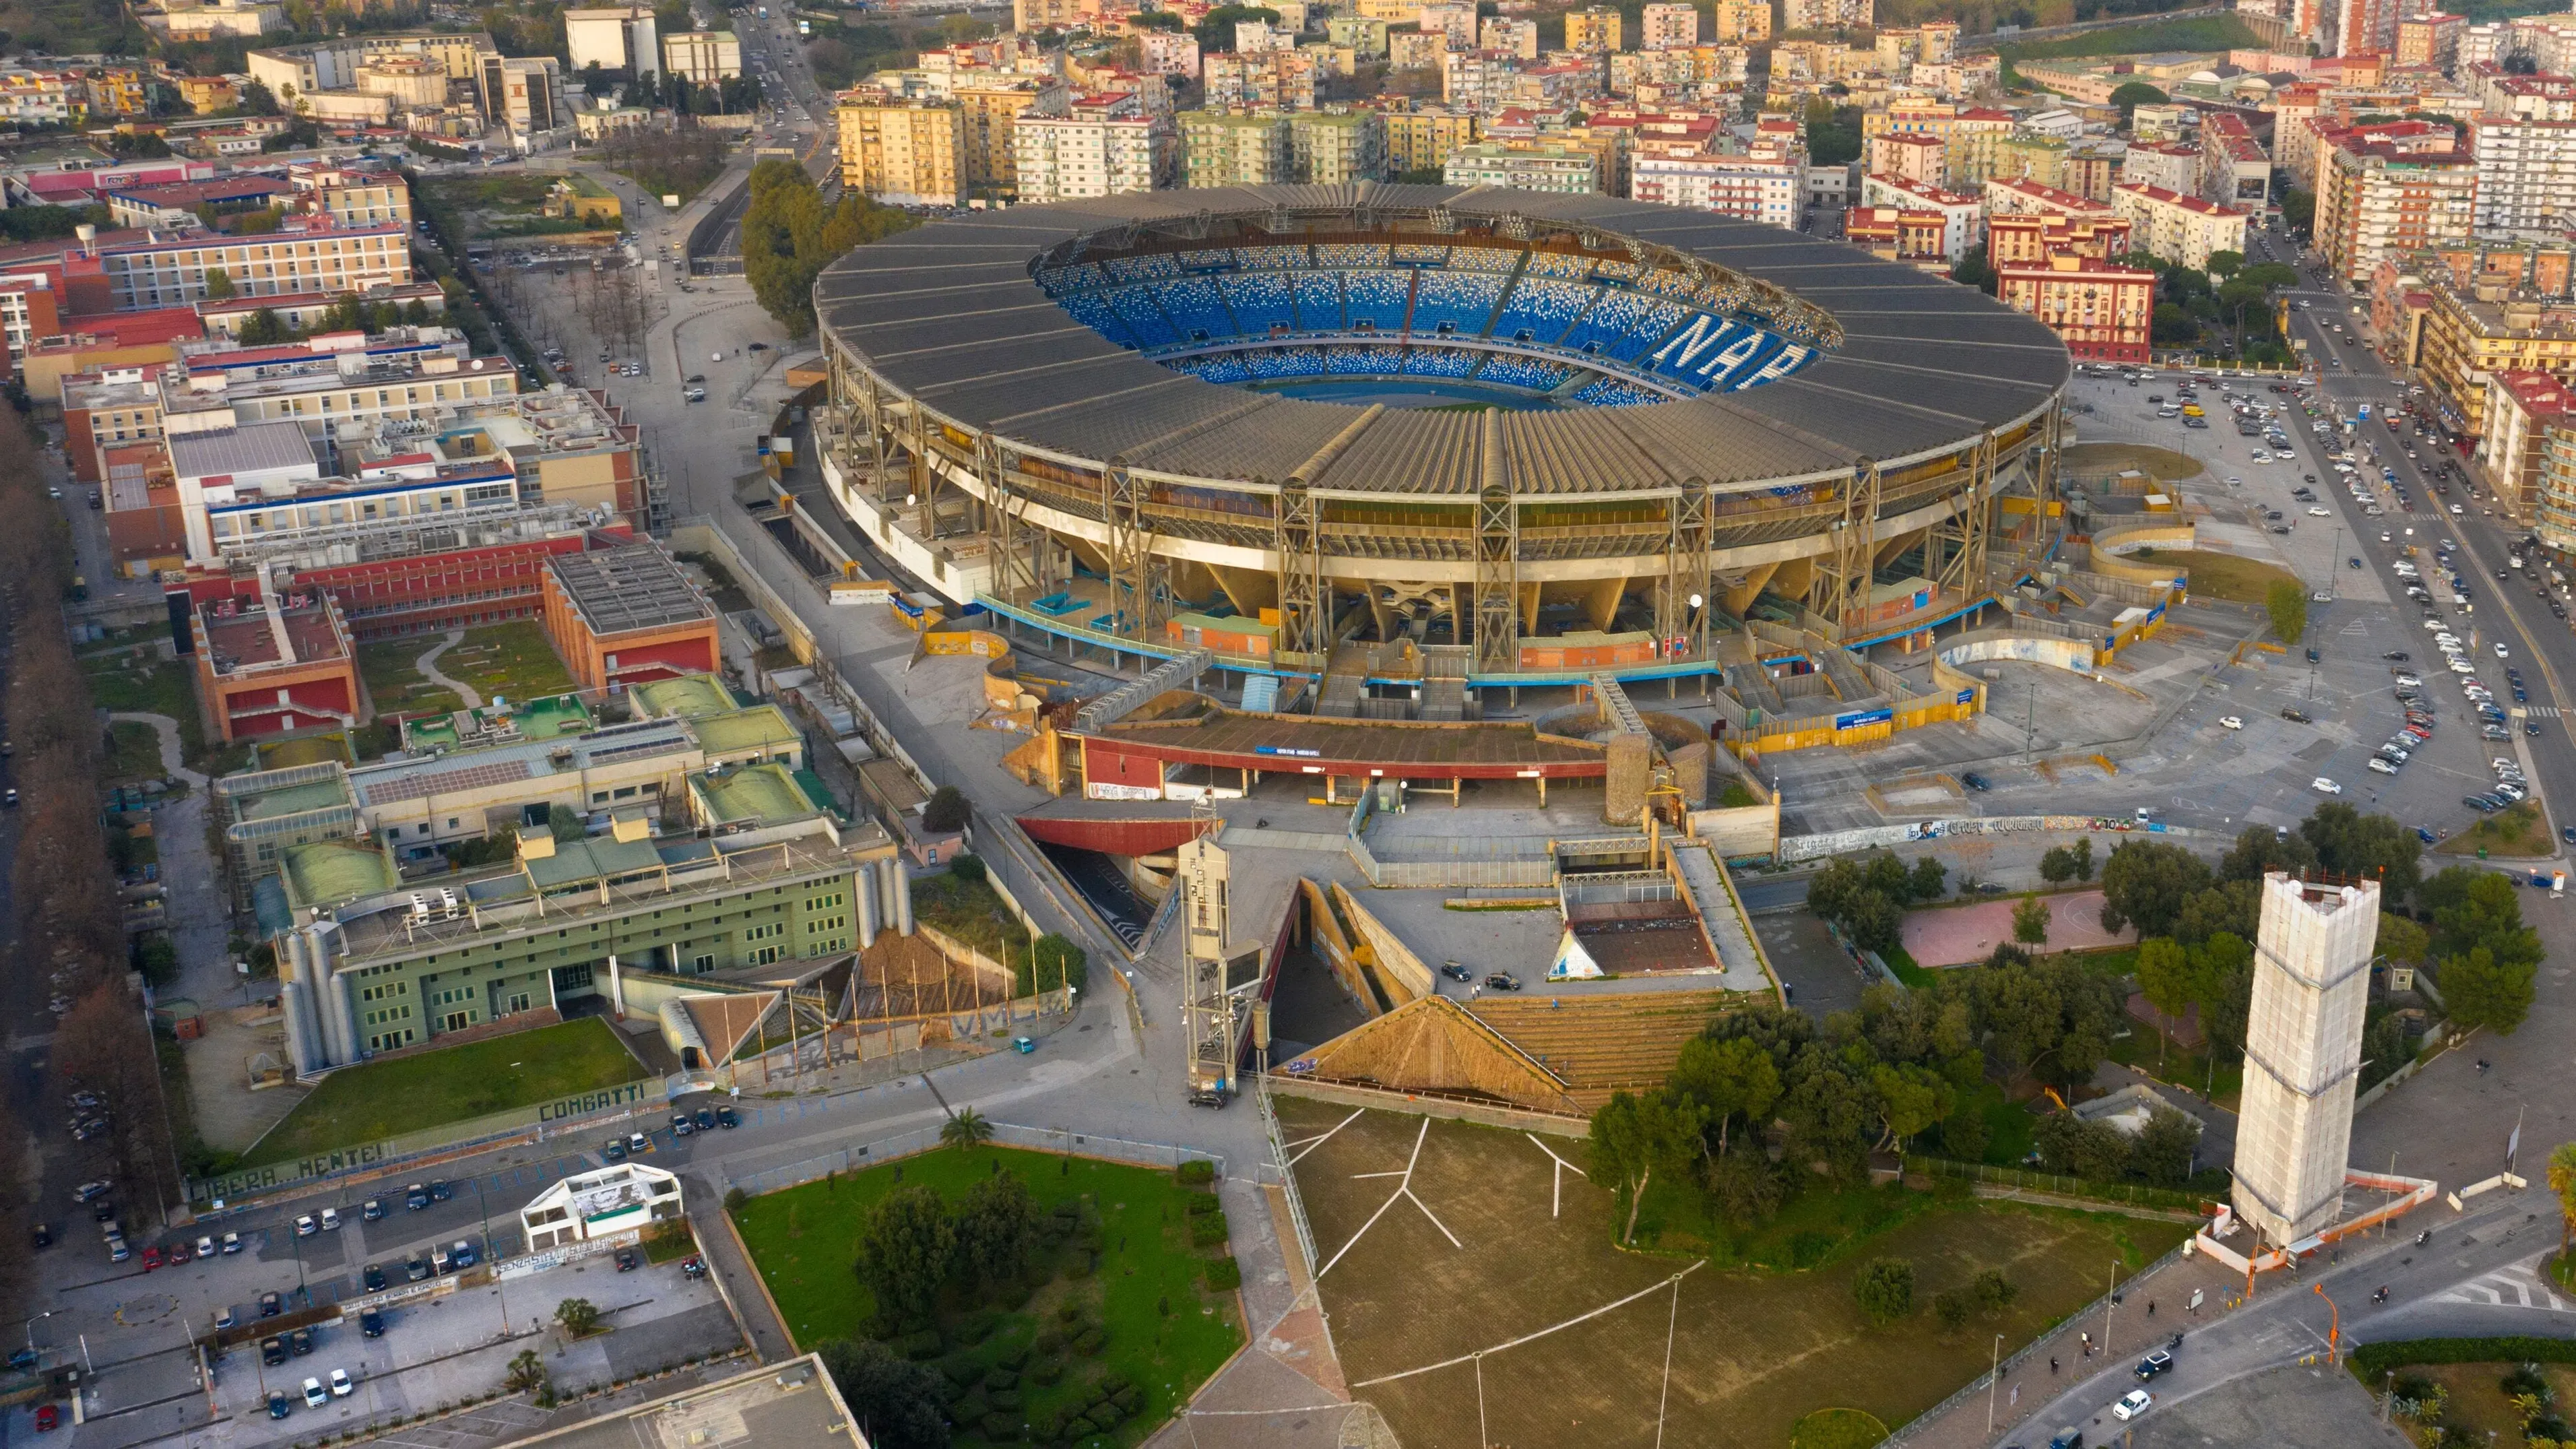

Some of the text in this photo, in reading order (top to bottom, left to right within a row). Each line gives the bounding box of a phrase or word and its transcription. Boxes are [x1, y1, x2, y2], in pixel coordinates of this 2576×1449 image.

[1652, 315, 1809, 390] NAP
[2103, 818, 2116, 830] 10
[539, 1083, 645, 1122] COMBATTI
[499, 1258, 530, 1273] SENZA
